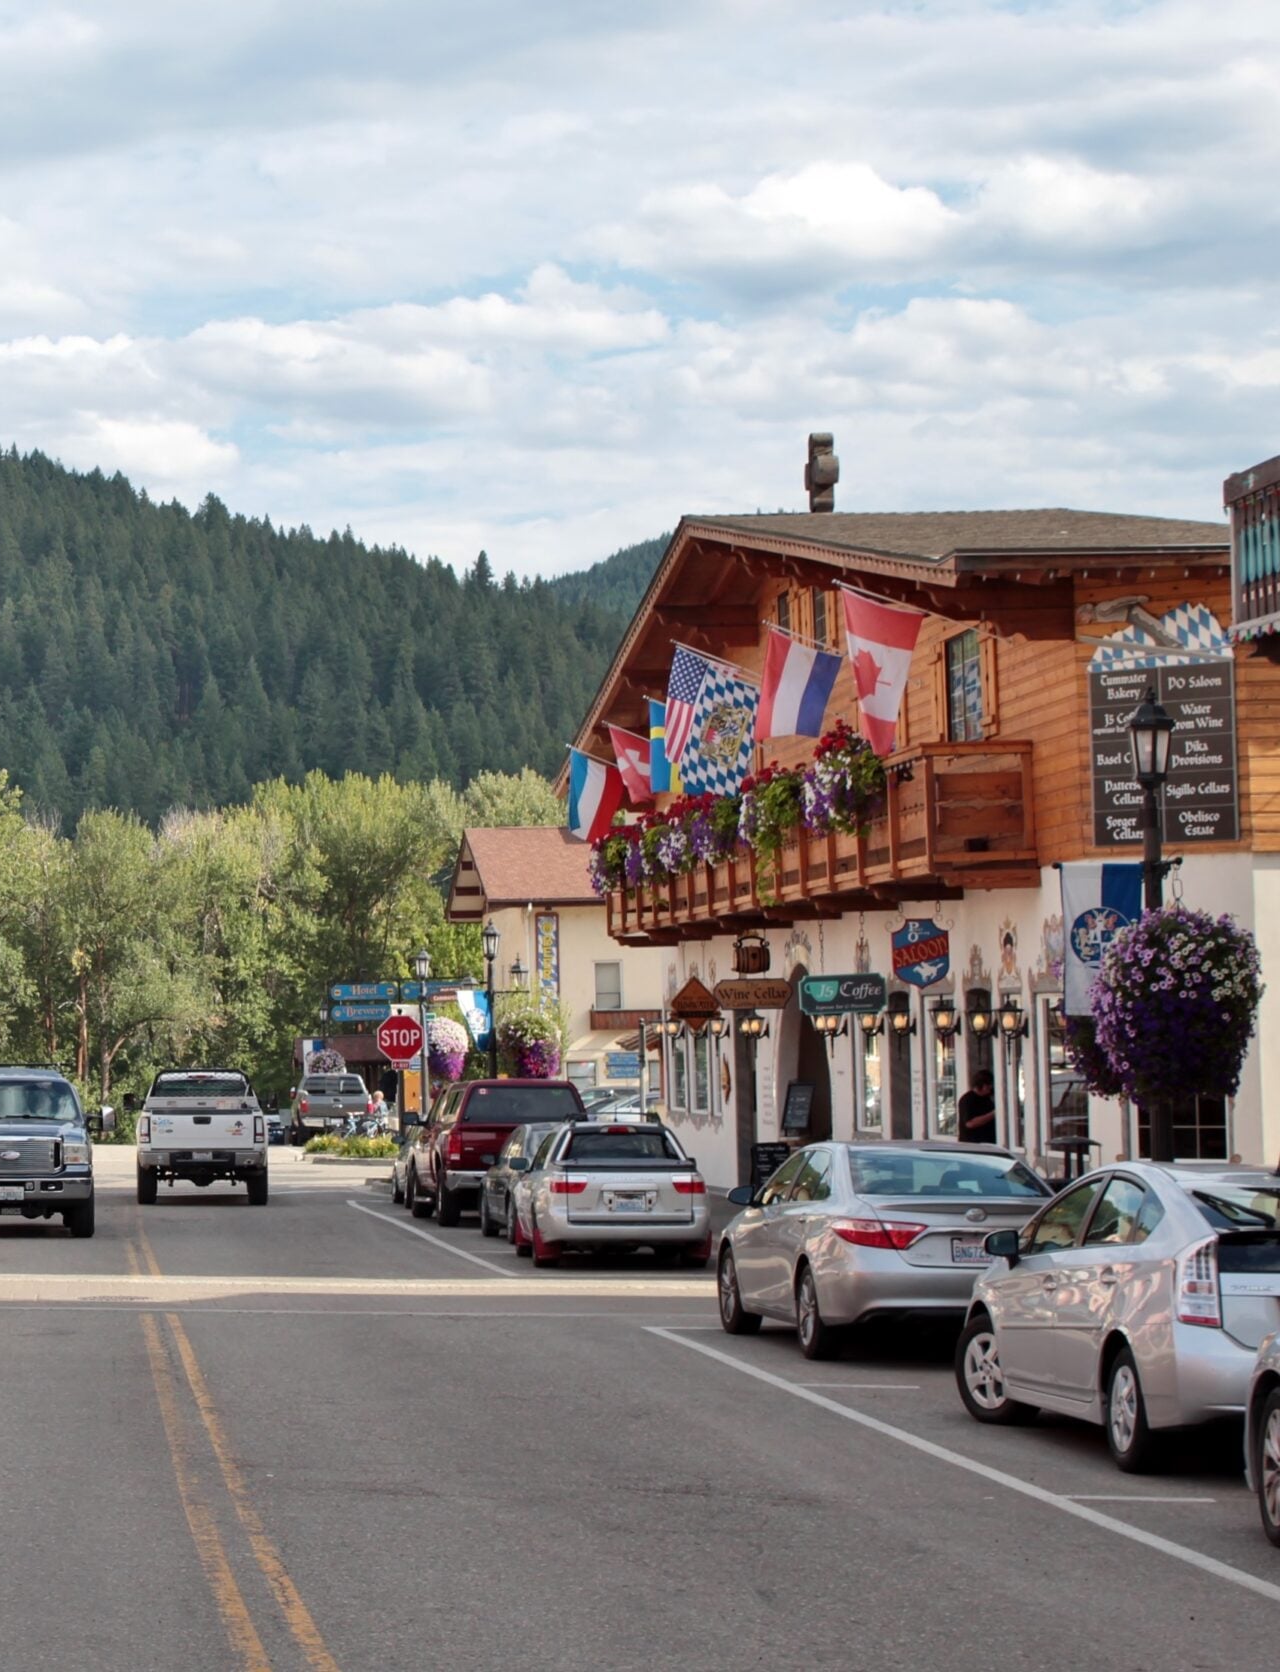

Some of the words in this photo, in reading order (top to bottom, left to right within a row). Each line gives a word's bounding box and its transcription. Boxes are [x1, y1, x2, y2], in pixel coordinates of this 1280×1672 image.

[1188, 675, 1222, 688] Saloon
[1107, 687, 1141, 700] Bakery
[1180, 703, 1211, 715] Water
[1196, 716, 1223, 728] Wine
[1185, 740, 1208, 754] Pika
[1096, 752, 1122, 766] Basel
[1171, 754, 1223, 768] Provisions
[1166, 783, 1196, 799] Sigillo
[1197, 782, 1230, 794] Cellars
[1178, 810, 1220, 823] Obelisco
[1184, 824, 1215, 836] Estate
[352, 984, 377, 996] Hotel
[719, 987, 748, 1000] Wine
[754, 987, 787, 1000] Cellar
[839, 981, 882, 1000] Coffee
[380, 1029, 421, 1047] STOP
